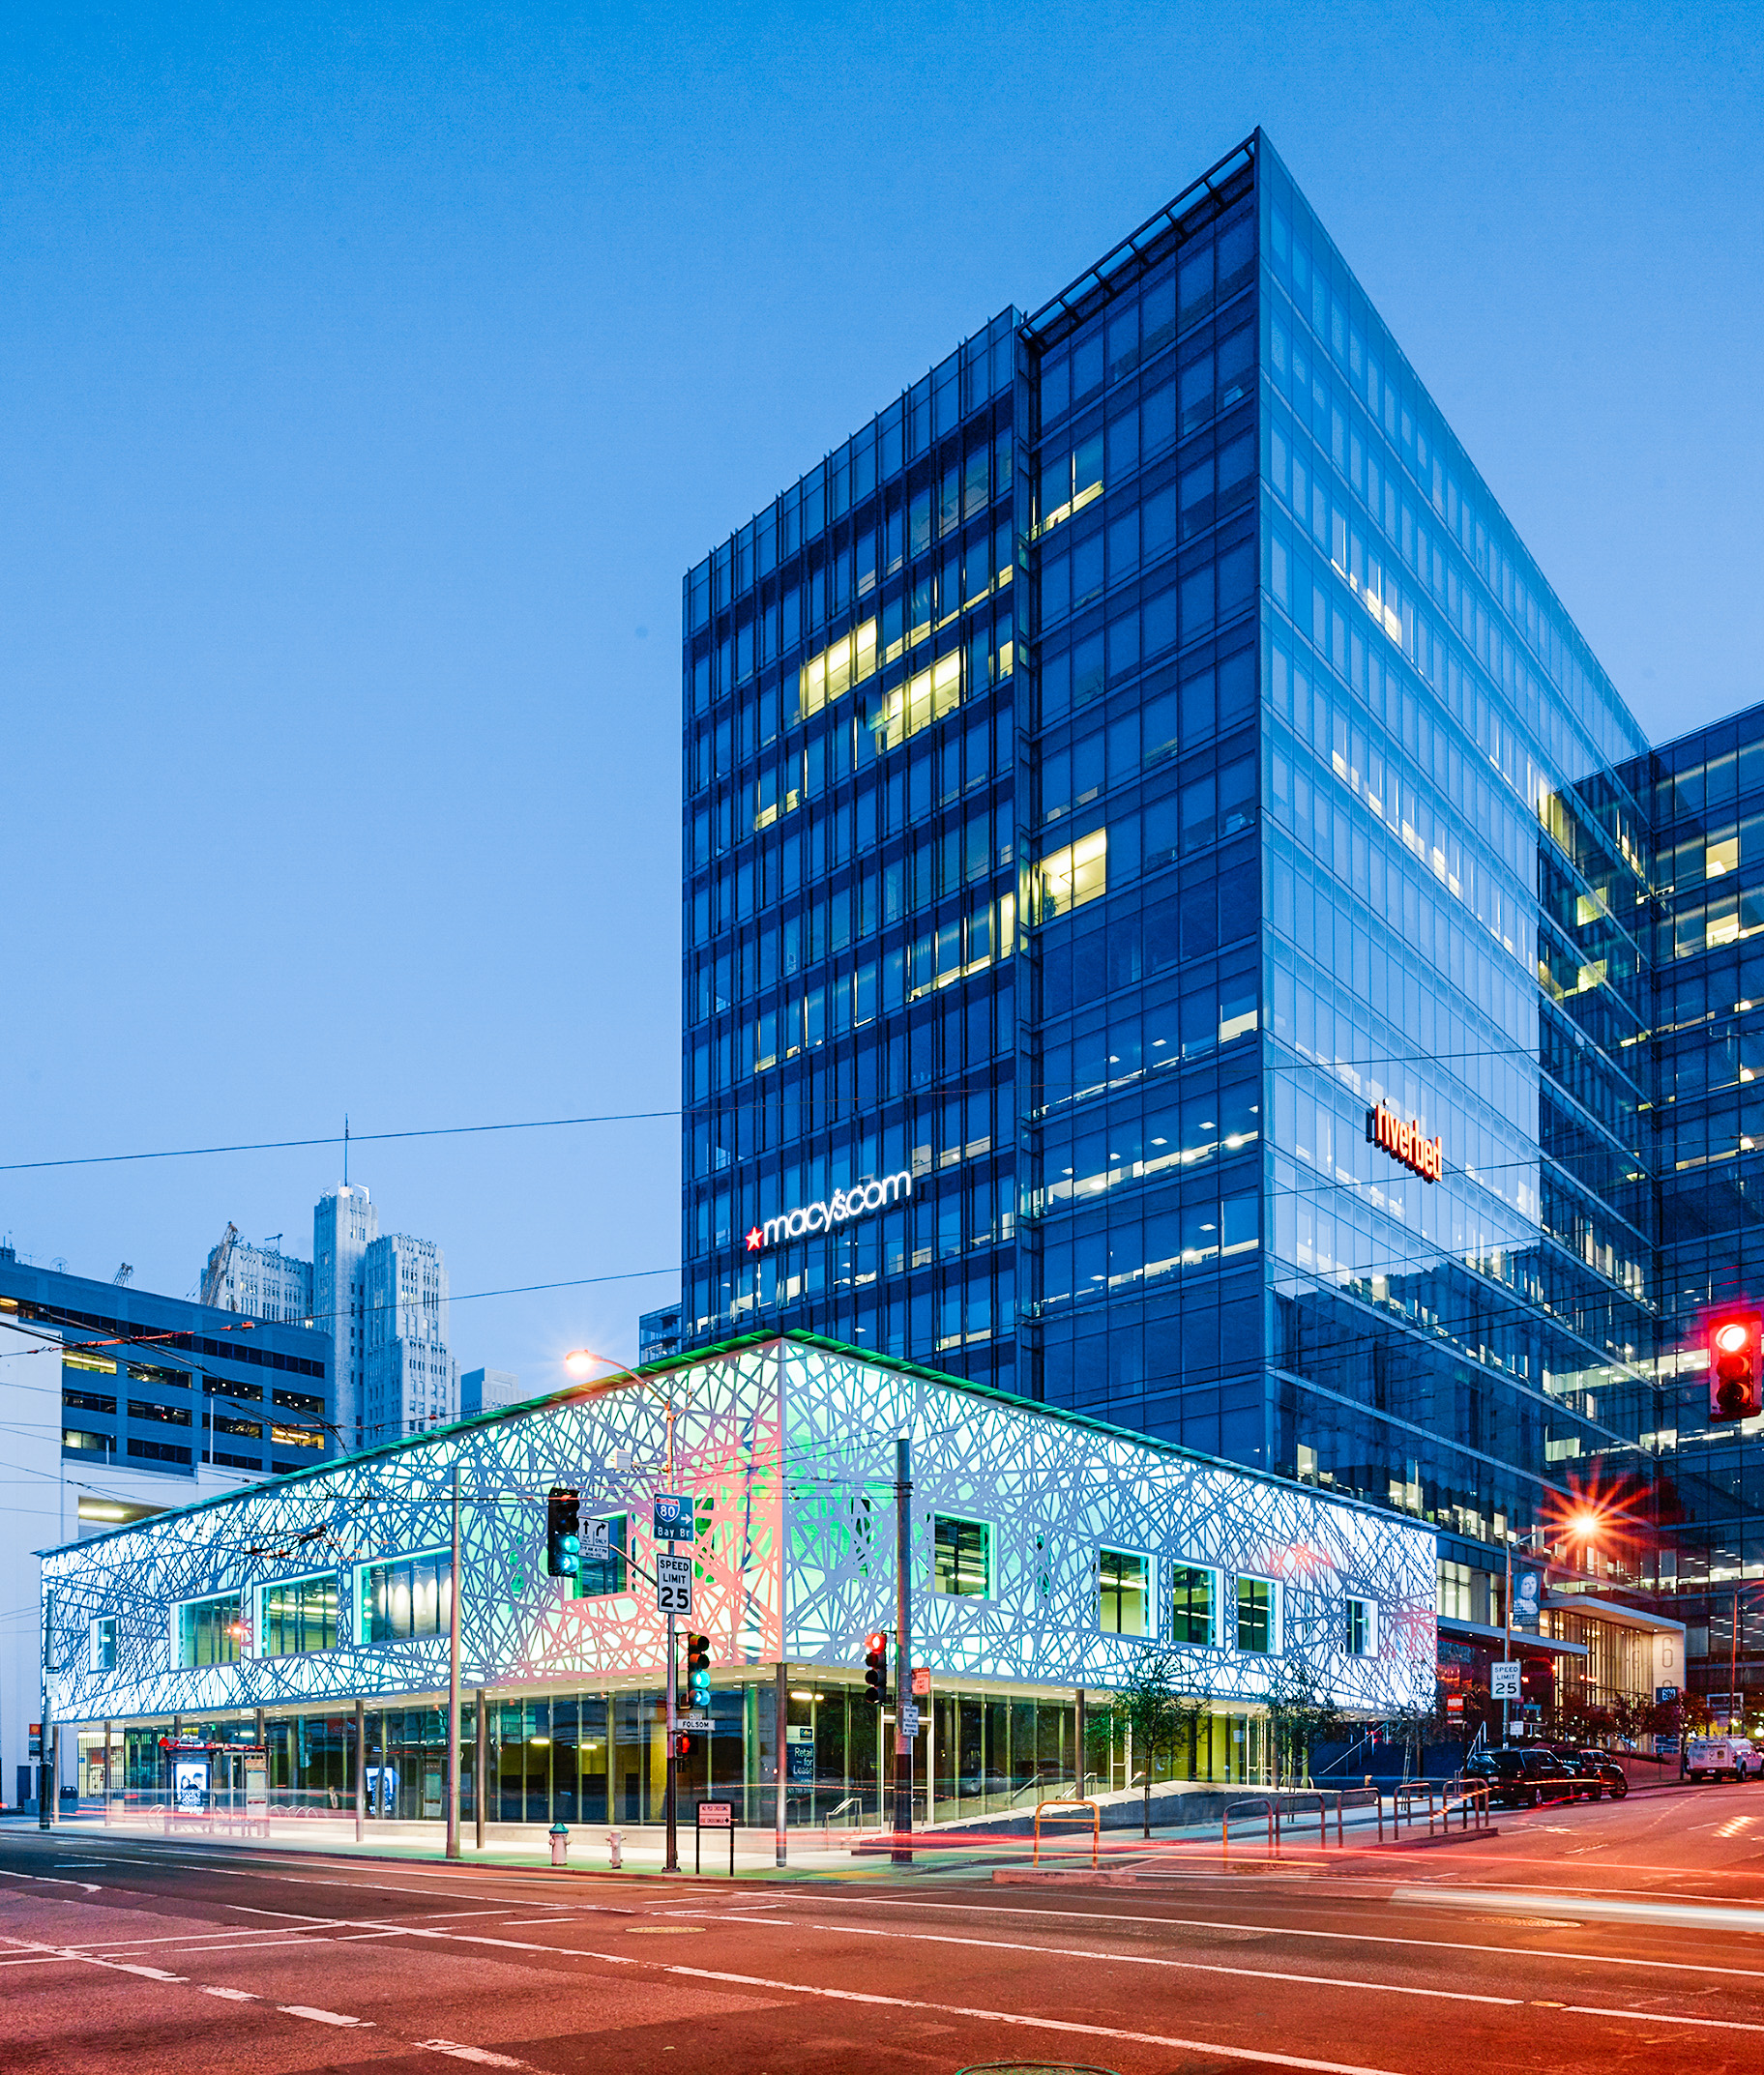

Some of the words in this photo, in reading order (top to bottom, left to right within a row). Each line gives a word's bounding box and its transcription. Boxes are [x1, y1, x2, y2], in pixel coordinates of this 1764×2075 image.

[1374, 1103, 1442, 1182] riverbed
[660, 1505, 676, 1518] 80
[658, 1526, 674, 1537] Bay
[679, 1528, 690, 1537] Br
[660, 1560, 690, 1572] SPEED
[662, 1573, 687, 1585] LIMIT
[661, 1586, 689, 1609] 25
[1495, 1682, 1517, 1694] 25
[682, 1720, 710, 1729] FOLSOM
[794, 1746, 813, 1757] Retail
[804, 1757, 813, 1767] for
[793, 1765, 813, 1775] Lease
